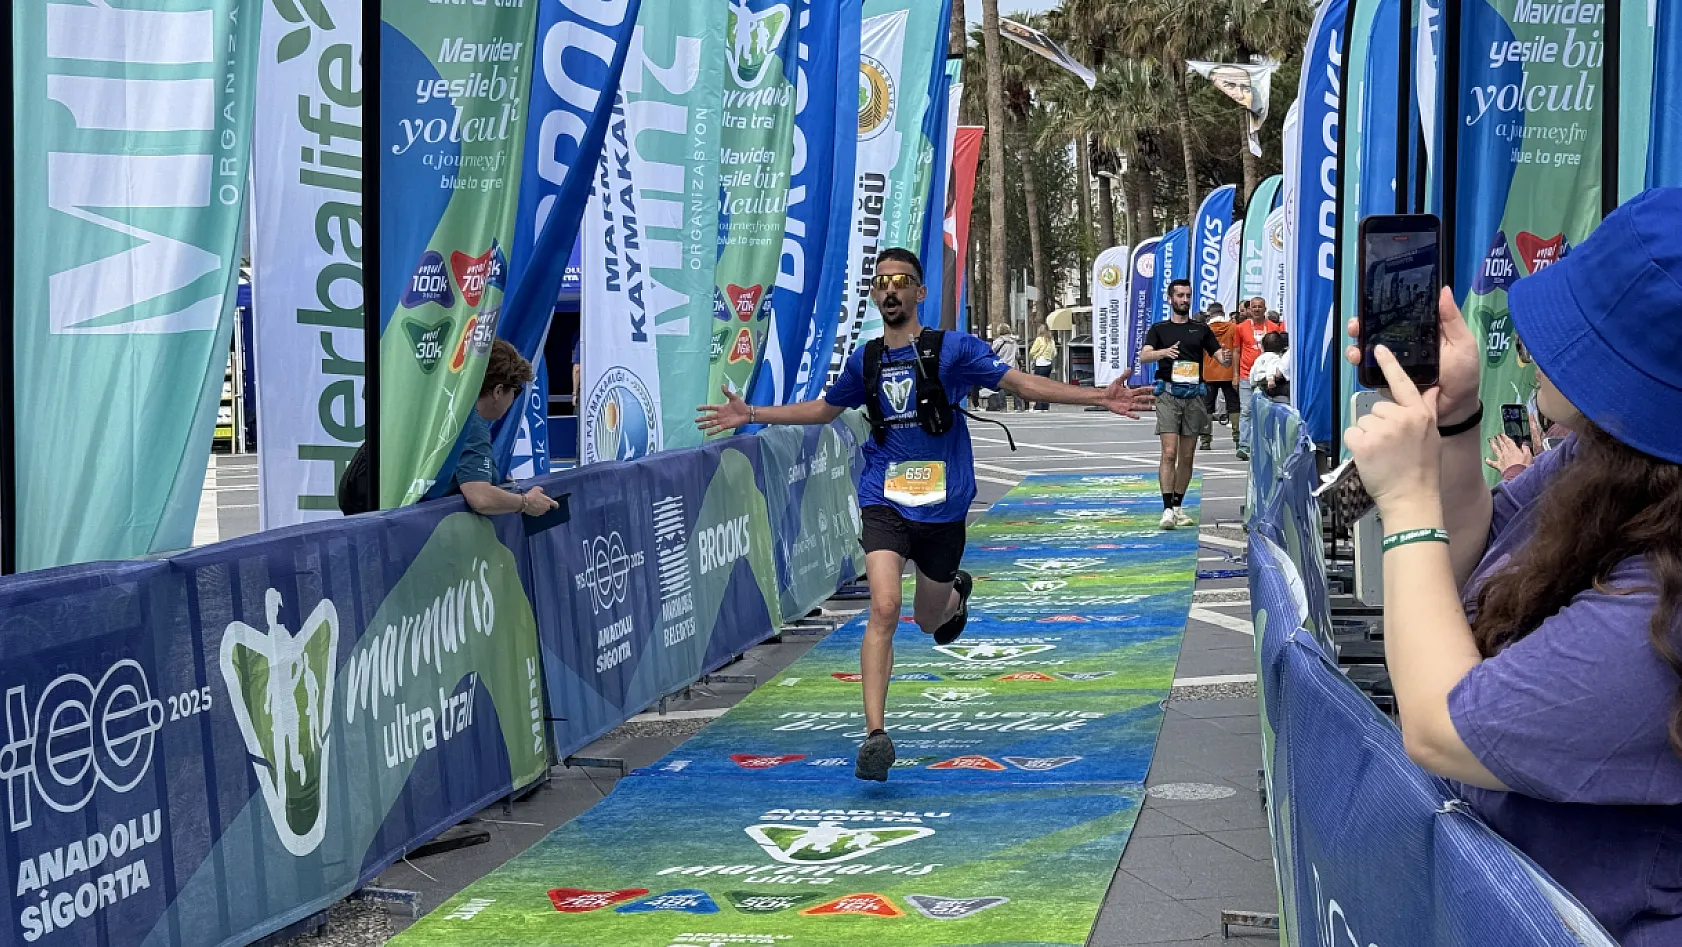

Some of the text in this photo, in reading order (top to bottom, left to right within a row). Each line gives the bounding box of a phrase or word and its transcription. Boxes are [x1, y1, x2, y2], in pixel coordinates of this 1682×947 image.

[1535, 148, 1550, 164] to
[1199, 215, 1223, 311] BROOKS
[412, 275, 449, 292] 100k
[415, 342, 443, 359] 30k
[473, 326, 493, 342] 5k
[905, 467, 932, 480] 653
[698, 513, 750, 575] BROOKS
[346, 556, 495, 724] marmaris
[168, 686, 213, 722] 2025
[384, 703, 437, 769] ultra
[16, 808, 163, 897] ANADOLU
[743, 875, 835, 885] ultra
[20, 858, 151, 943] SİGORTA
